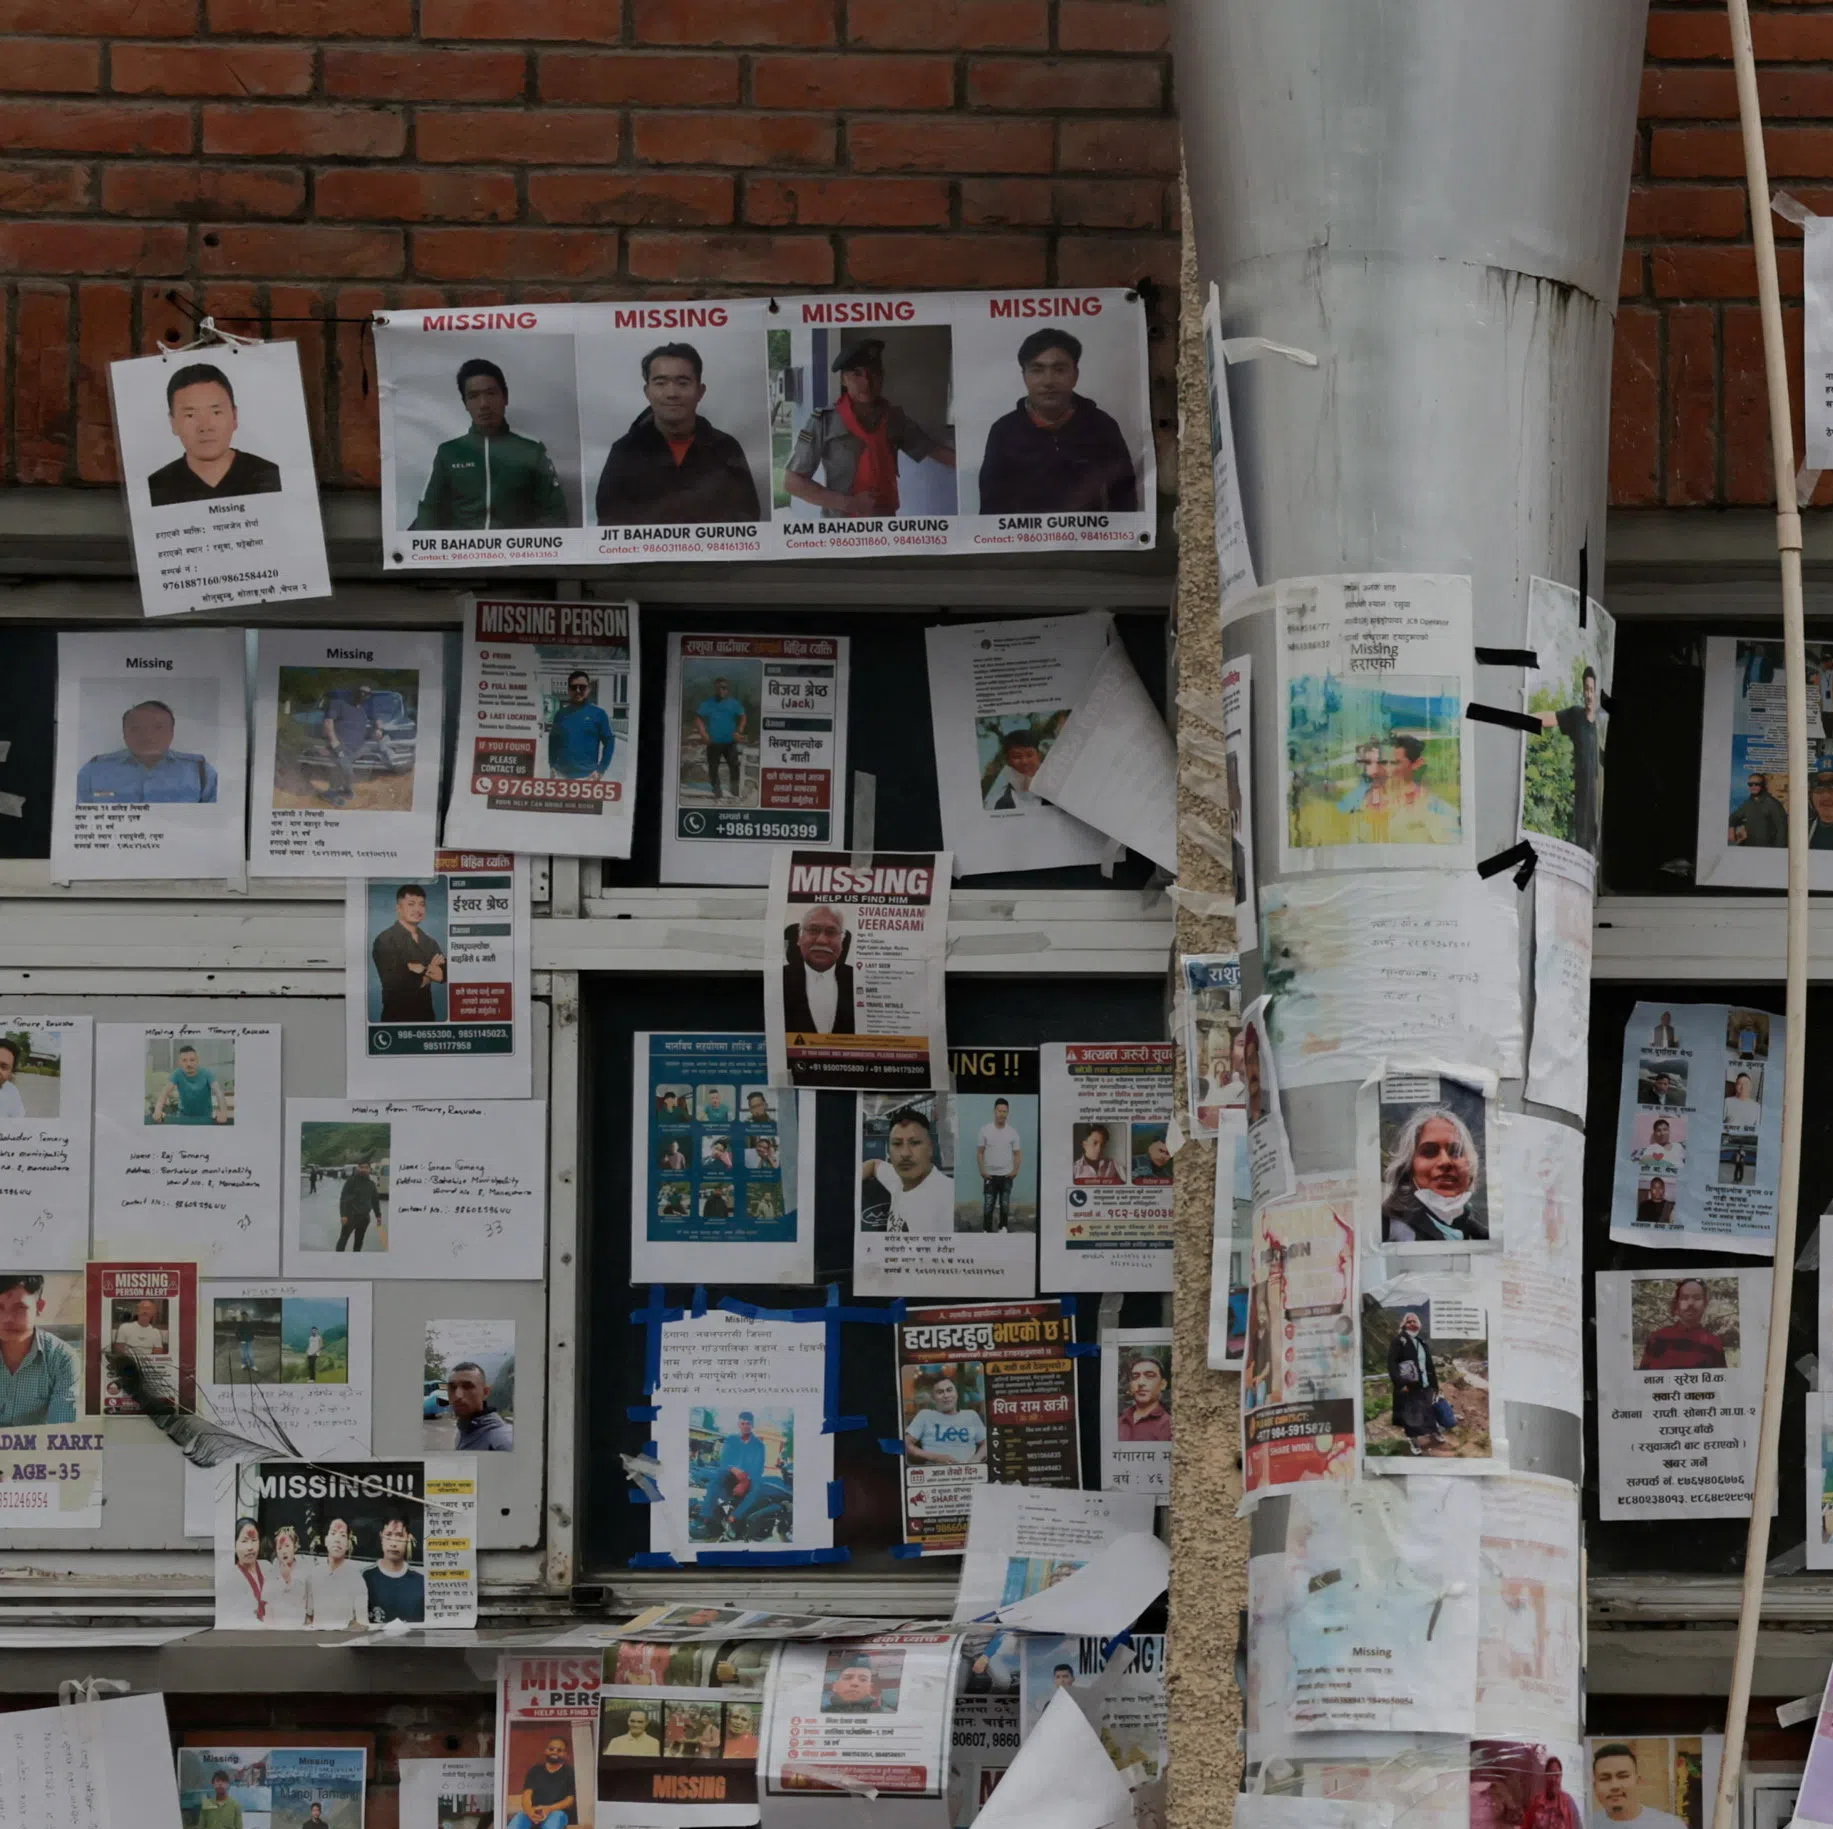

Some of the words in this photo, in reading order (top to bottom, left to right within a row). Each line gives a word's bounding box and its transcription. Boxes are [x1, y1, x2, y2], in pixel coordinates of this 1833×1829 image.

[802, 301, 915, 323] MISSING
[990, 297, 1102, 318] MISSING
[423, 312, 537, 332] MISSING
[615, 308, 728, 328] MISSING
[208, 503, 246, 514] Missing
[784, 523, 814, 536] KAM
[819, 521, 883, 534] BAHADUR
[888, 519, 949, 532] GURUNG
[998, 516, 1042, 530] SAMIR
[1047, 515, 1109, 528] GURUNG
[601, 529, 619, 541] JIT
[624, 527, 690, 540] BAHADUR
[695, 525, 757, 539] GURUNG
[412, 539, 437, 551] PUR
[441, 538, 502, 550] BAHADUR
[506, 537, 563, 549] GURUNG
[481, 605, 557, 634] MISSING
[561, 607, 627, 637] PERSON
[326, 648, 374, 662] Missing
[126, 657, 174, 671] Missing
[781, 698, 815, 710] (Jack)
[498, 779, 616, 800] 9768539565
[716, 823, 817, 838] +9861950399
[792, 866, 928, 895] MISSING
[814, 894, 842, 903] HELP
[844, 895, 859, 903] US
[861, 895, 886, 904] FIND
[888, 896, 908, 904] HIM
[934, 1423, 969, 1443] Lee
[0, 1434, 37, 1451] DAM
[11, 1463, 81, 1481] AGE-35
